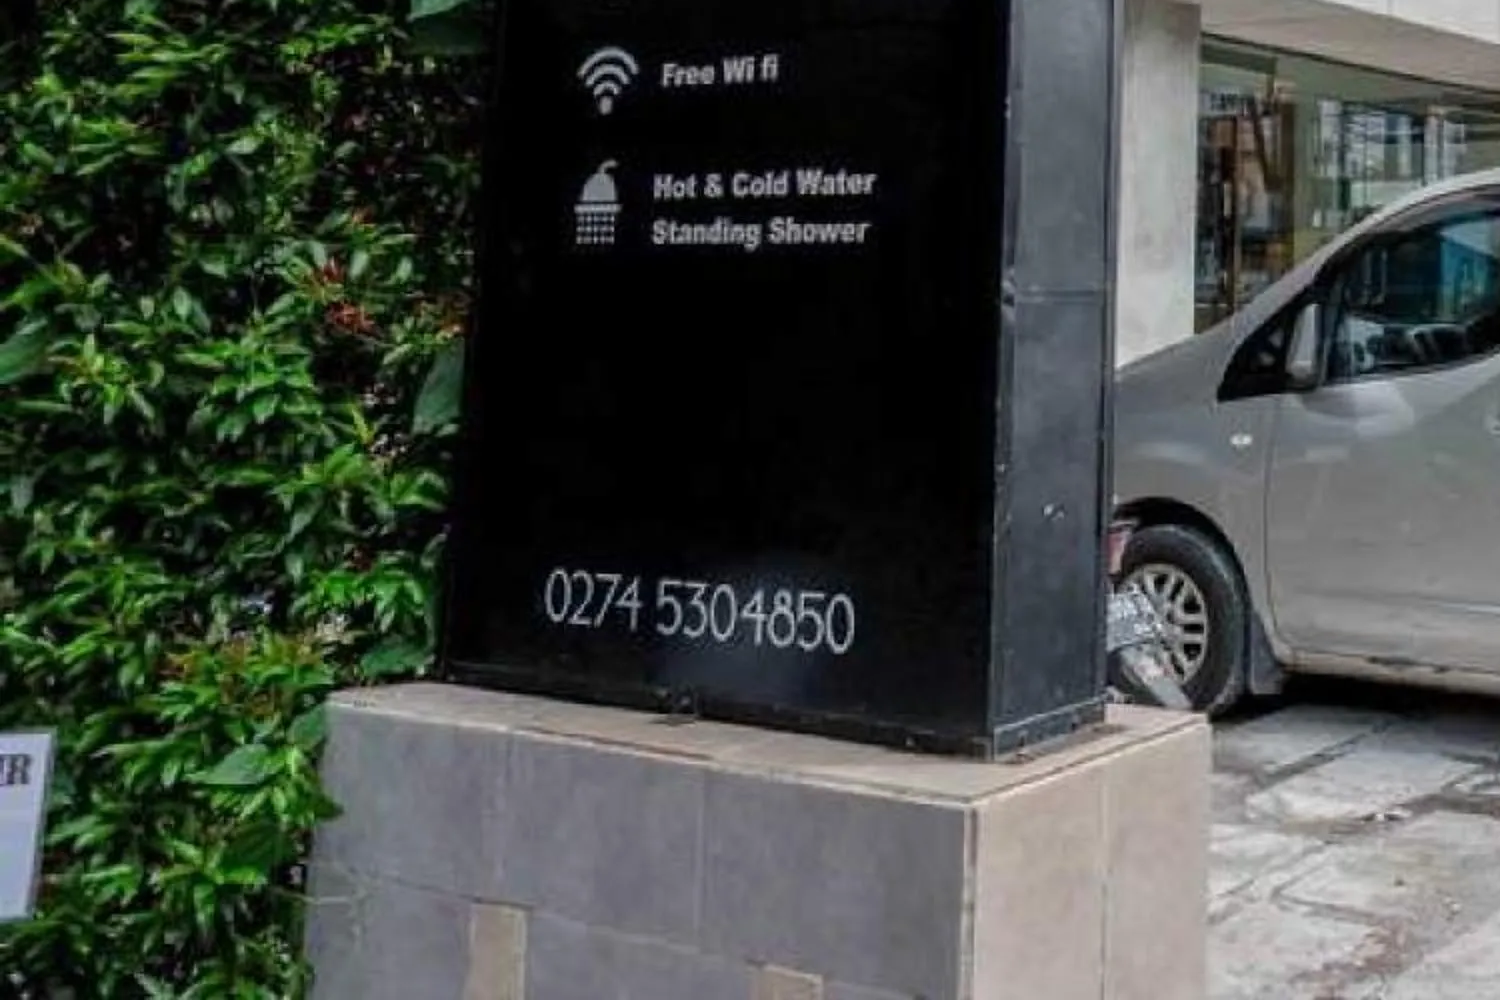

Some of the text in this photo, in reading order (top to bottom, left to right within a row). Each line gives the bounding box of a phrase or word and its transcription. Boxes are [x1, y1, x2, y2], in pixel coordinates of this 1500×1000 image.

[662, 63, 715, 87] Free
[653, 168, 877, 199] Hot & Cold Water
[652, 215, 872, 252] Standing Shower
[544, 569, 855, 655] 0274 5304850
